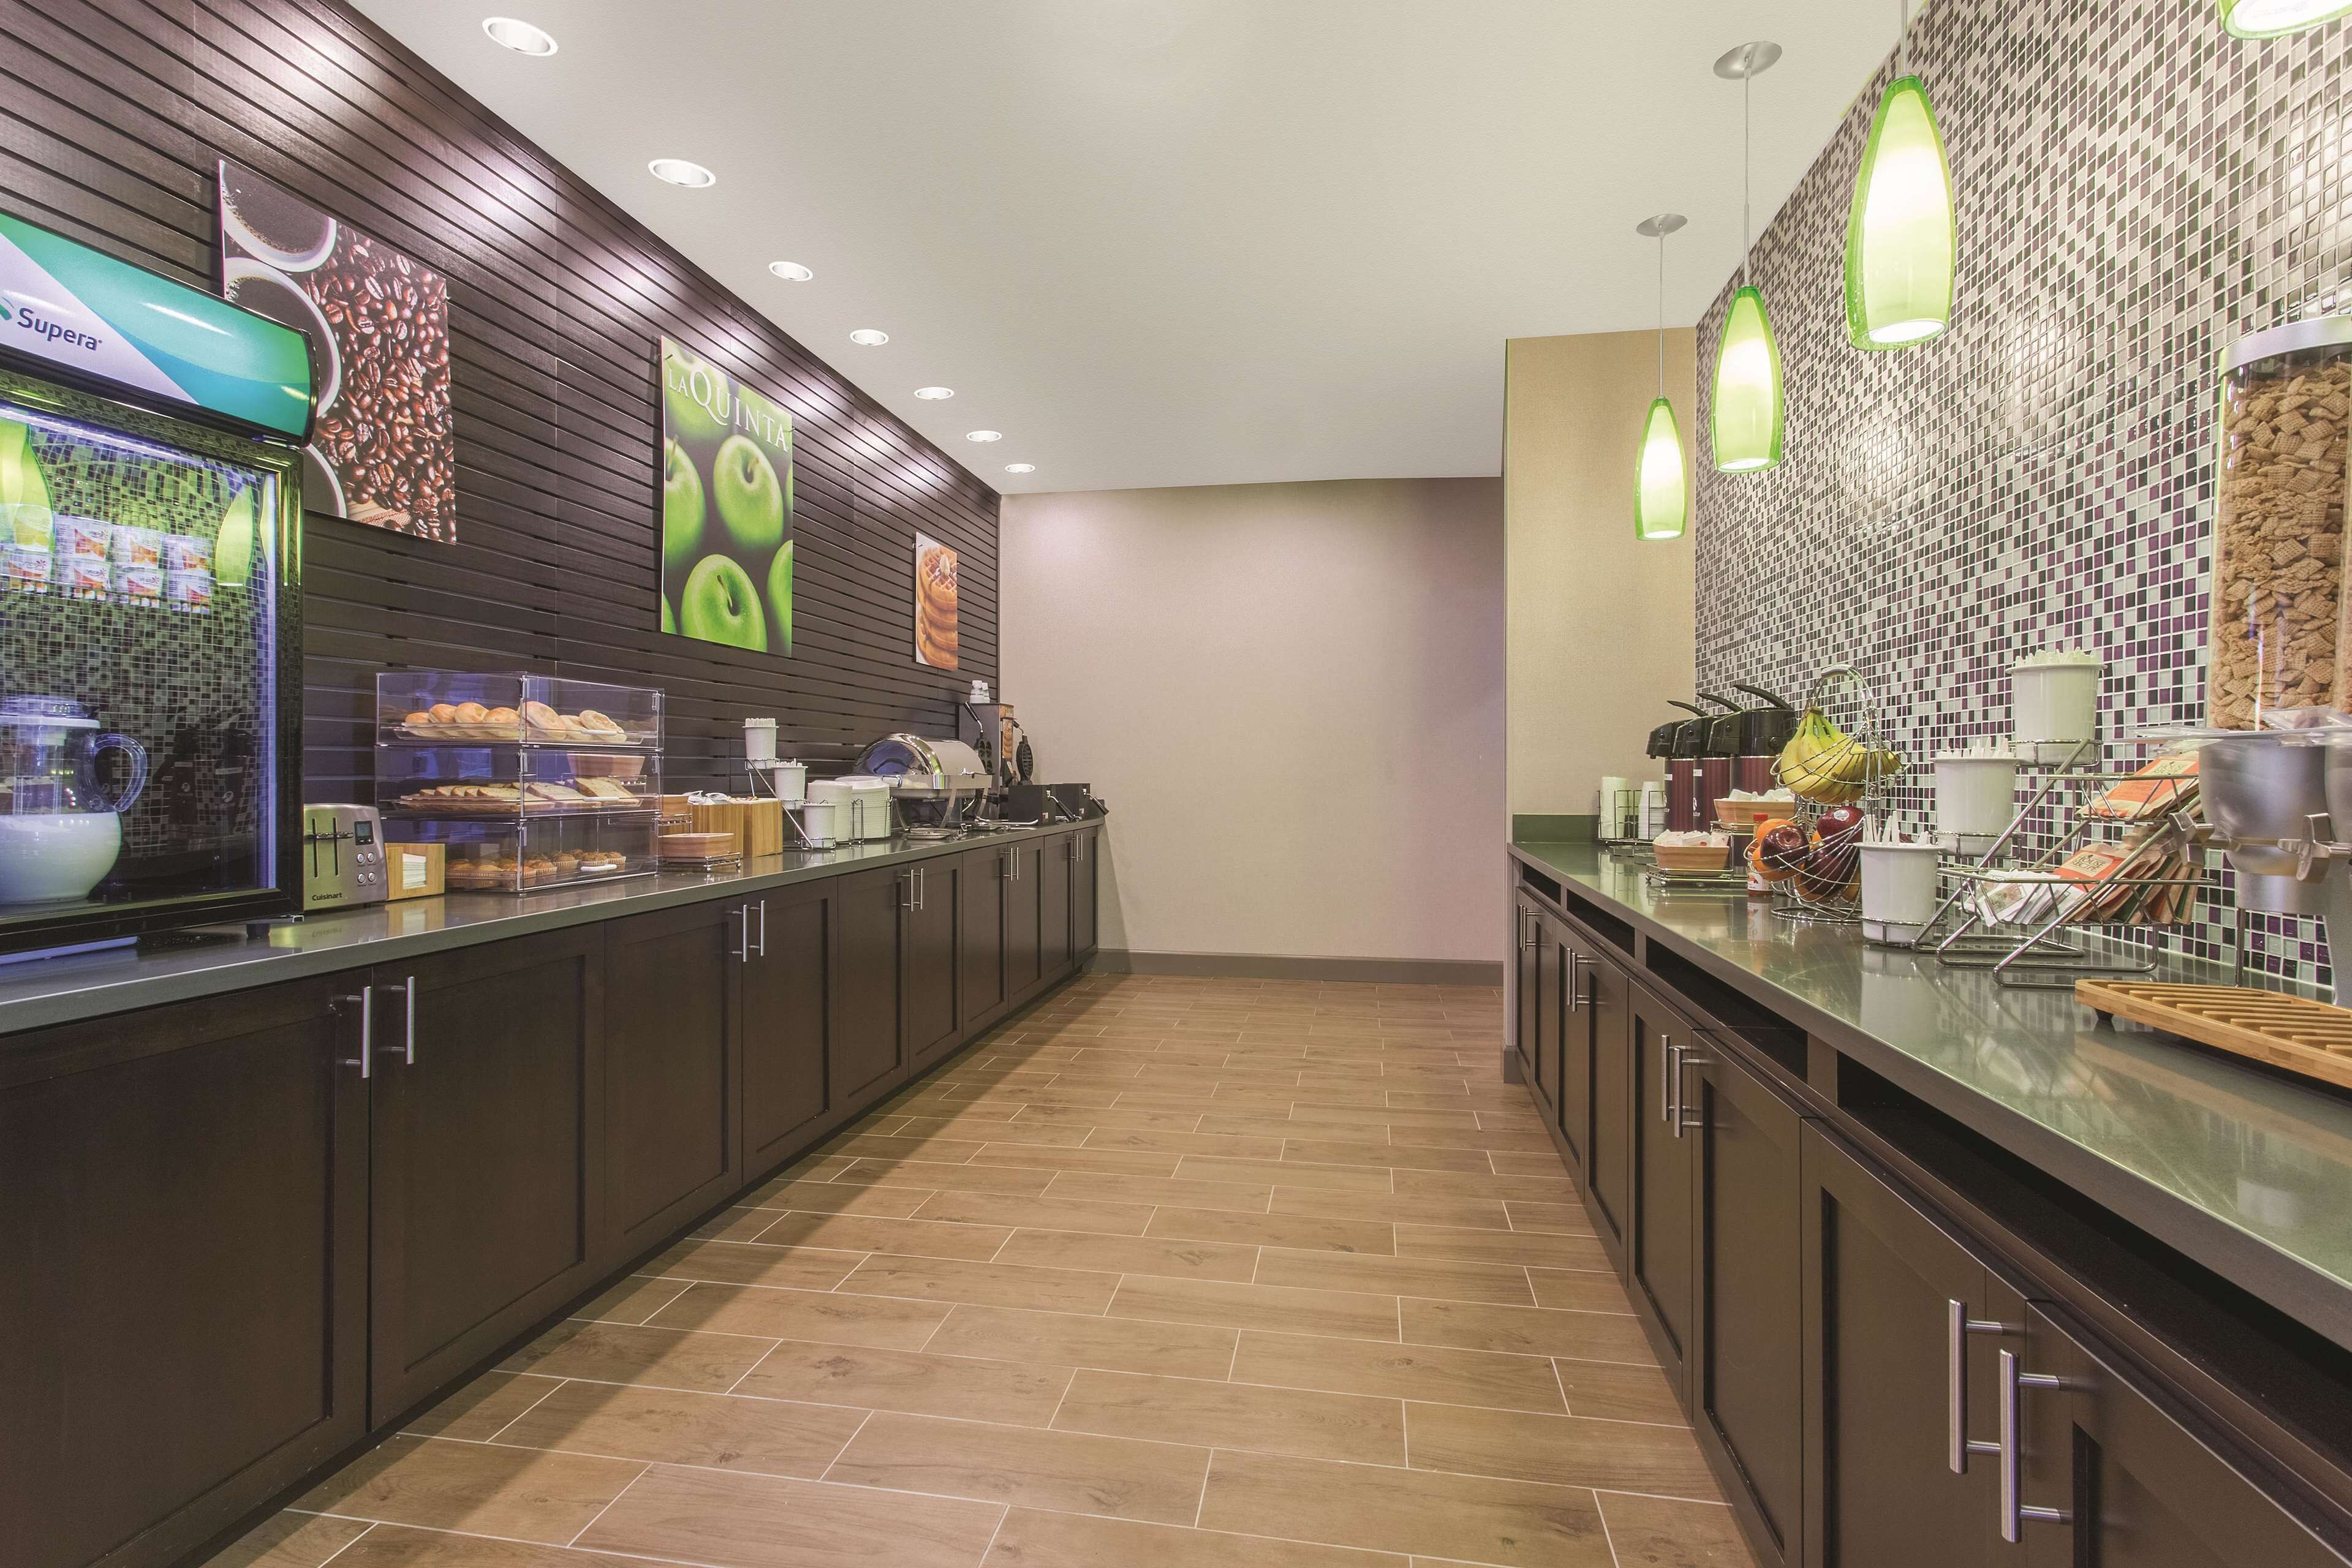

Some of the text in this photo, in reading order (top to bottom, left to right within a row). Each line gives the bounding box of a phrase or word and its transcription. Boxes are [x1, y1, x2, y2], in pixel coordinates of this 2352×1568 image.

[17, 307, 97, 351] Supera
[668, 369, 788, 453] LA QUINTA
[312, 892, 342, 901] Cuisinart
